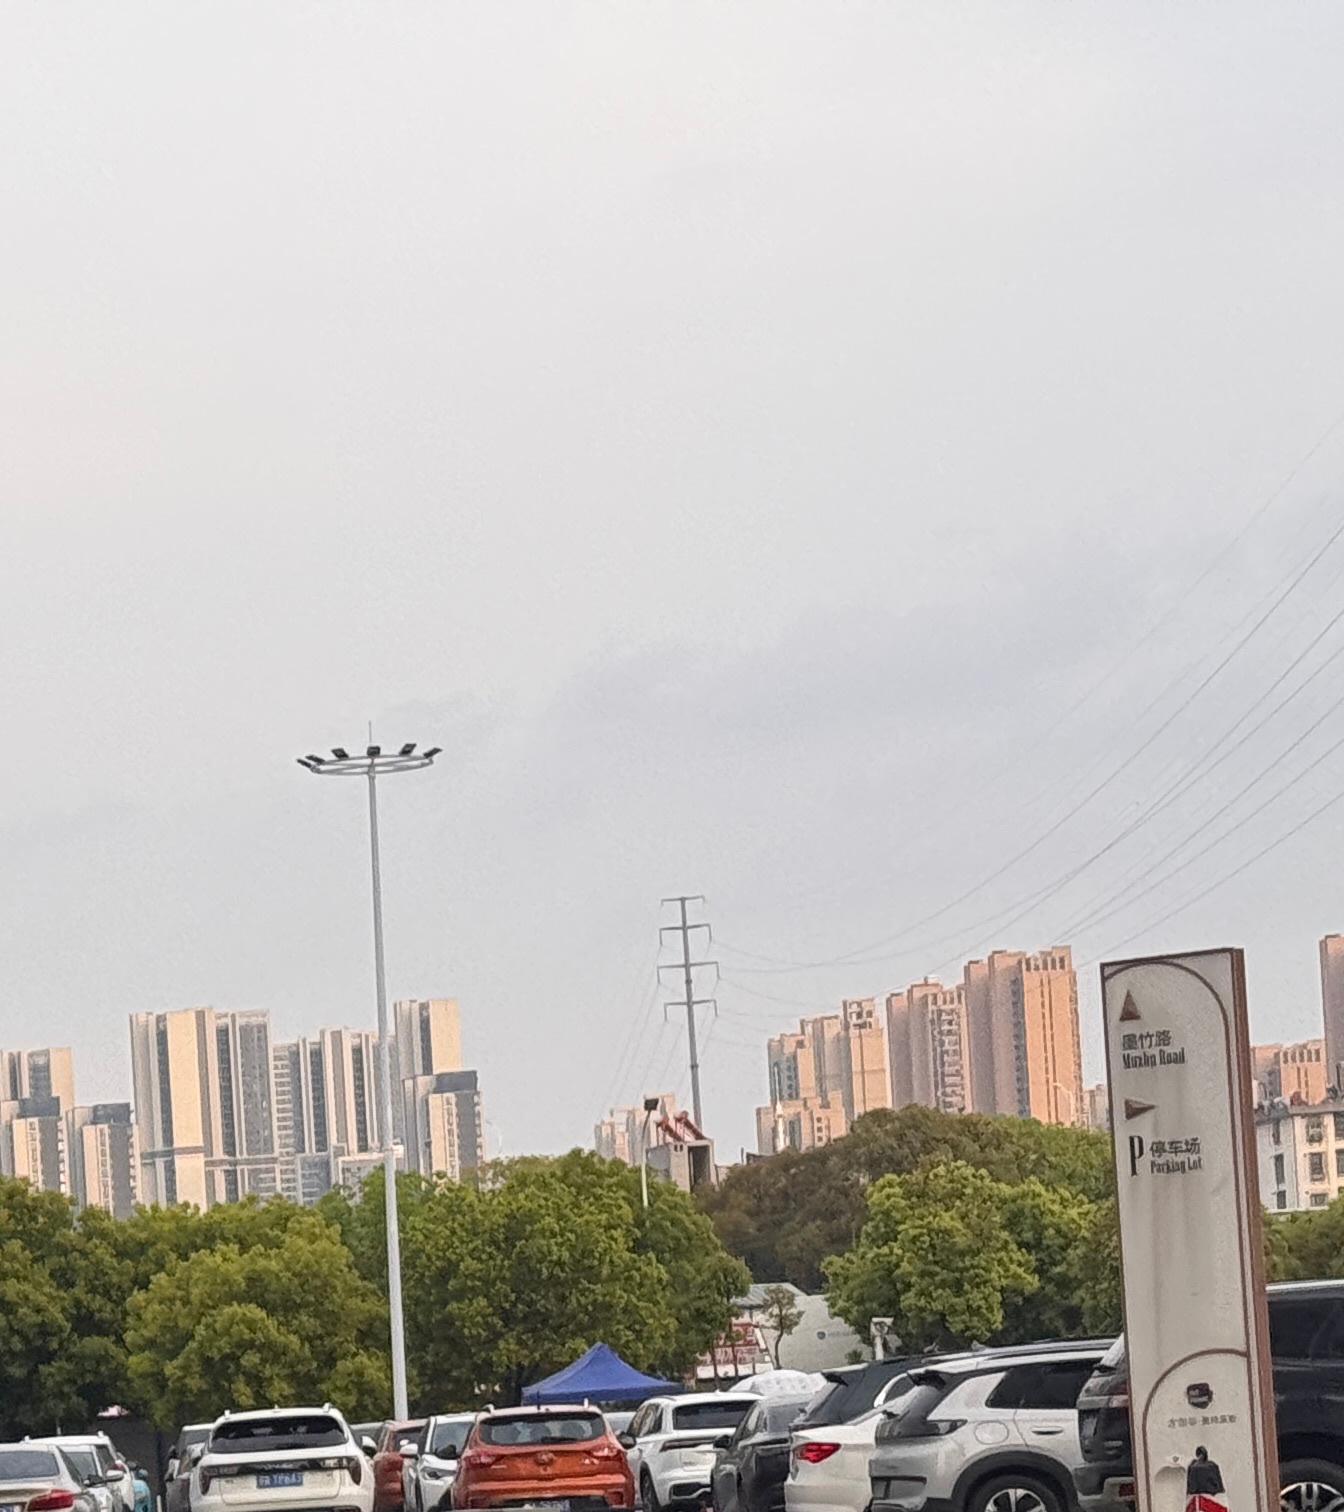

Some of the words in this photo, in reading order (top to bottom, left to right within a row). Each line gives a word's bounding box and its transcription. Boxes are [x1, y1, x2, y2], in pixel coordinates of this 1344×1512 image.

[1159, 1047, 1186, 1066] Road
[1129, 1135, 1144, 1177] P
[1150, 1137, 1201, 1158] 停车场
[1150, 1159, 1186, 1175] Parking
[1187, 1156, 1202, 1171] Lot
